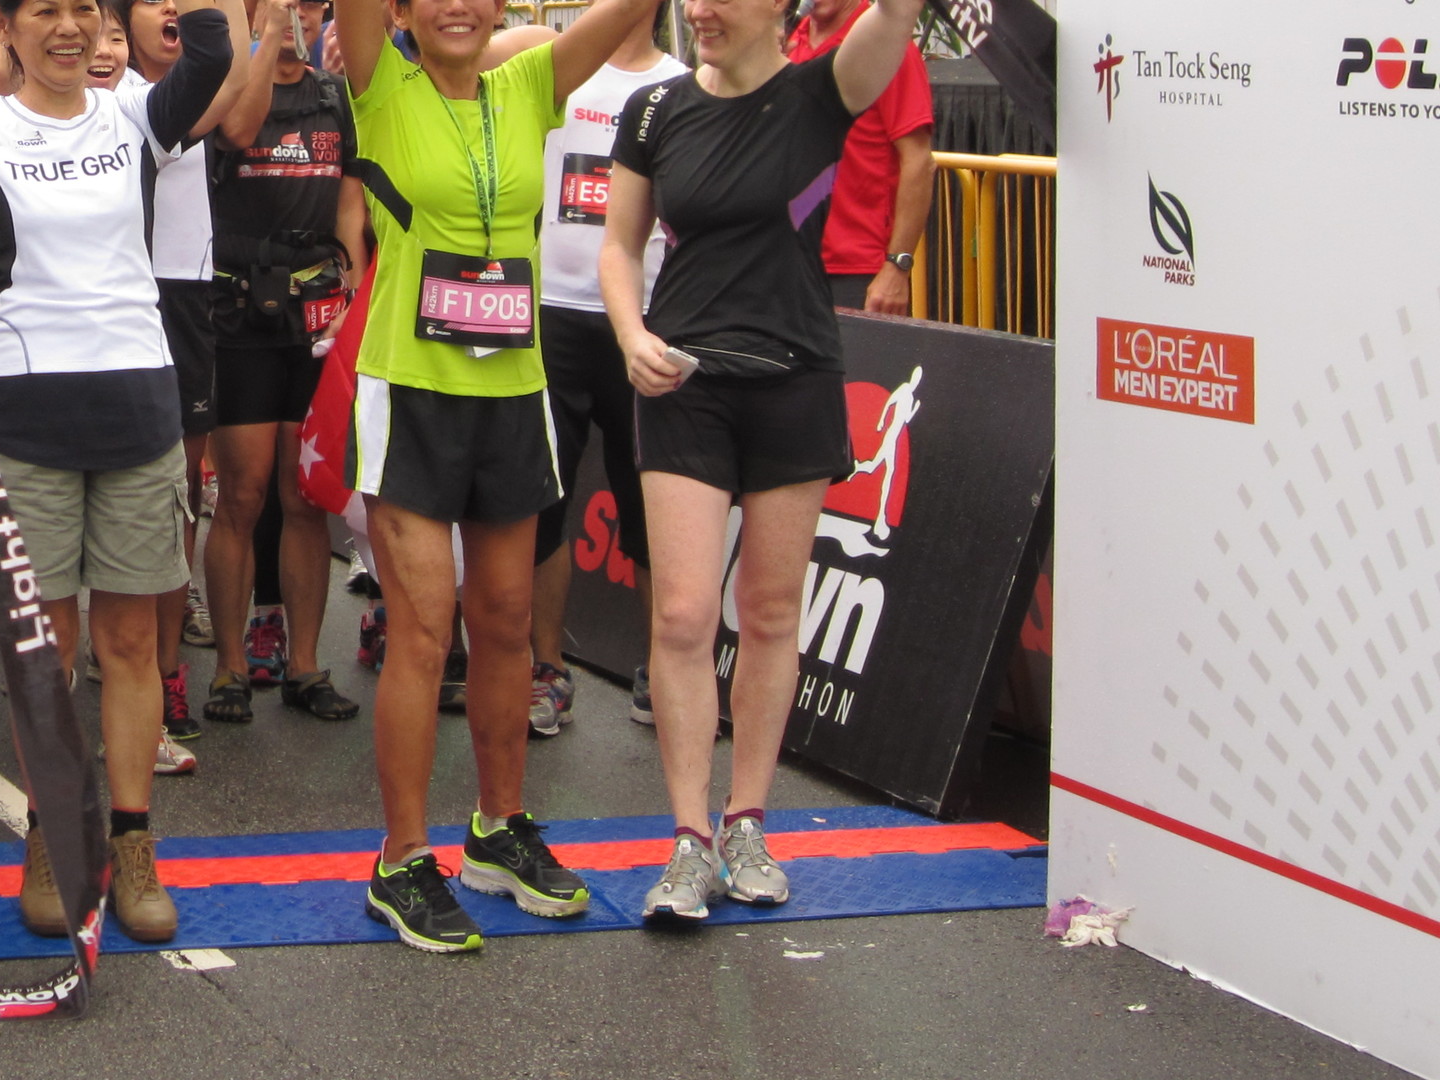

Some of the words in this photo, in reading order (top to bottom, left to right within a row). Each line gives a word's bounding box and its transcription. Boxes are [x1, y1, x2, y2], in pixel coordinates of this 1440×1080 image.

[1133, 50, 1162, 78] Tan
[1164, 51, 1206, 80] Tock
[1209, 51, 1252, 88] Seng
[1336, 36, 1440, 90] POL
[648, 85, 670, 104] OK
[1339, 101, 1397, 118] LISTENS
[1400, 104, 1420, 119] TO
[4, 160, 78, 182] TRUE
[80, 143, 132, 177] GRIT
[579, 181, 608, 205] E5
[1142, 255, 1191, 272] NATIONAL
[1164, 271, 1195, 286] PARKS
[428, 284, 439, 314] F42km
[442, 289, 529, 321] F1905
[1113, 327, 1238, 381] L'ORÉAL
[1114, 367, 1156, 400] MEN
[1160, 374, 1238, 412] EXPERT
